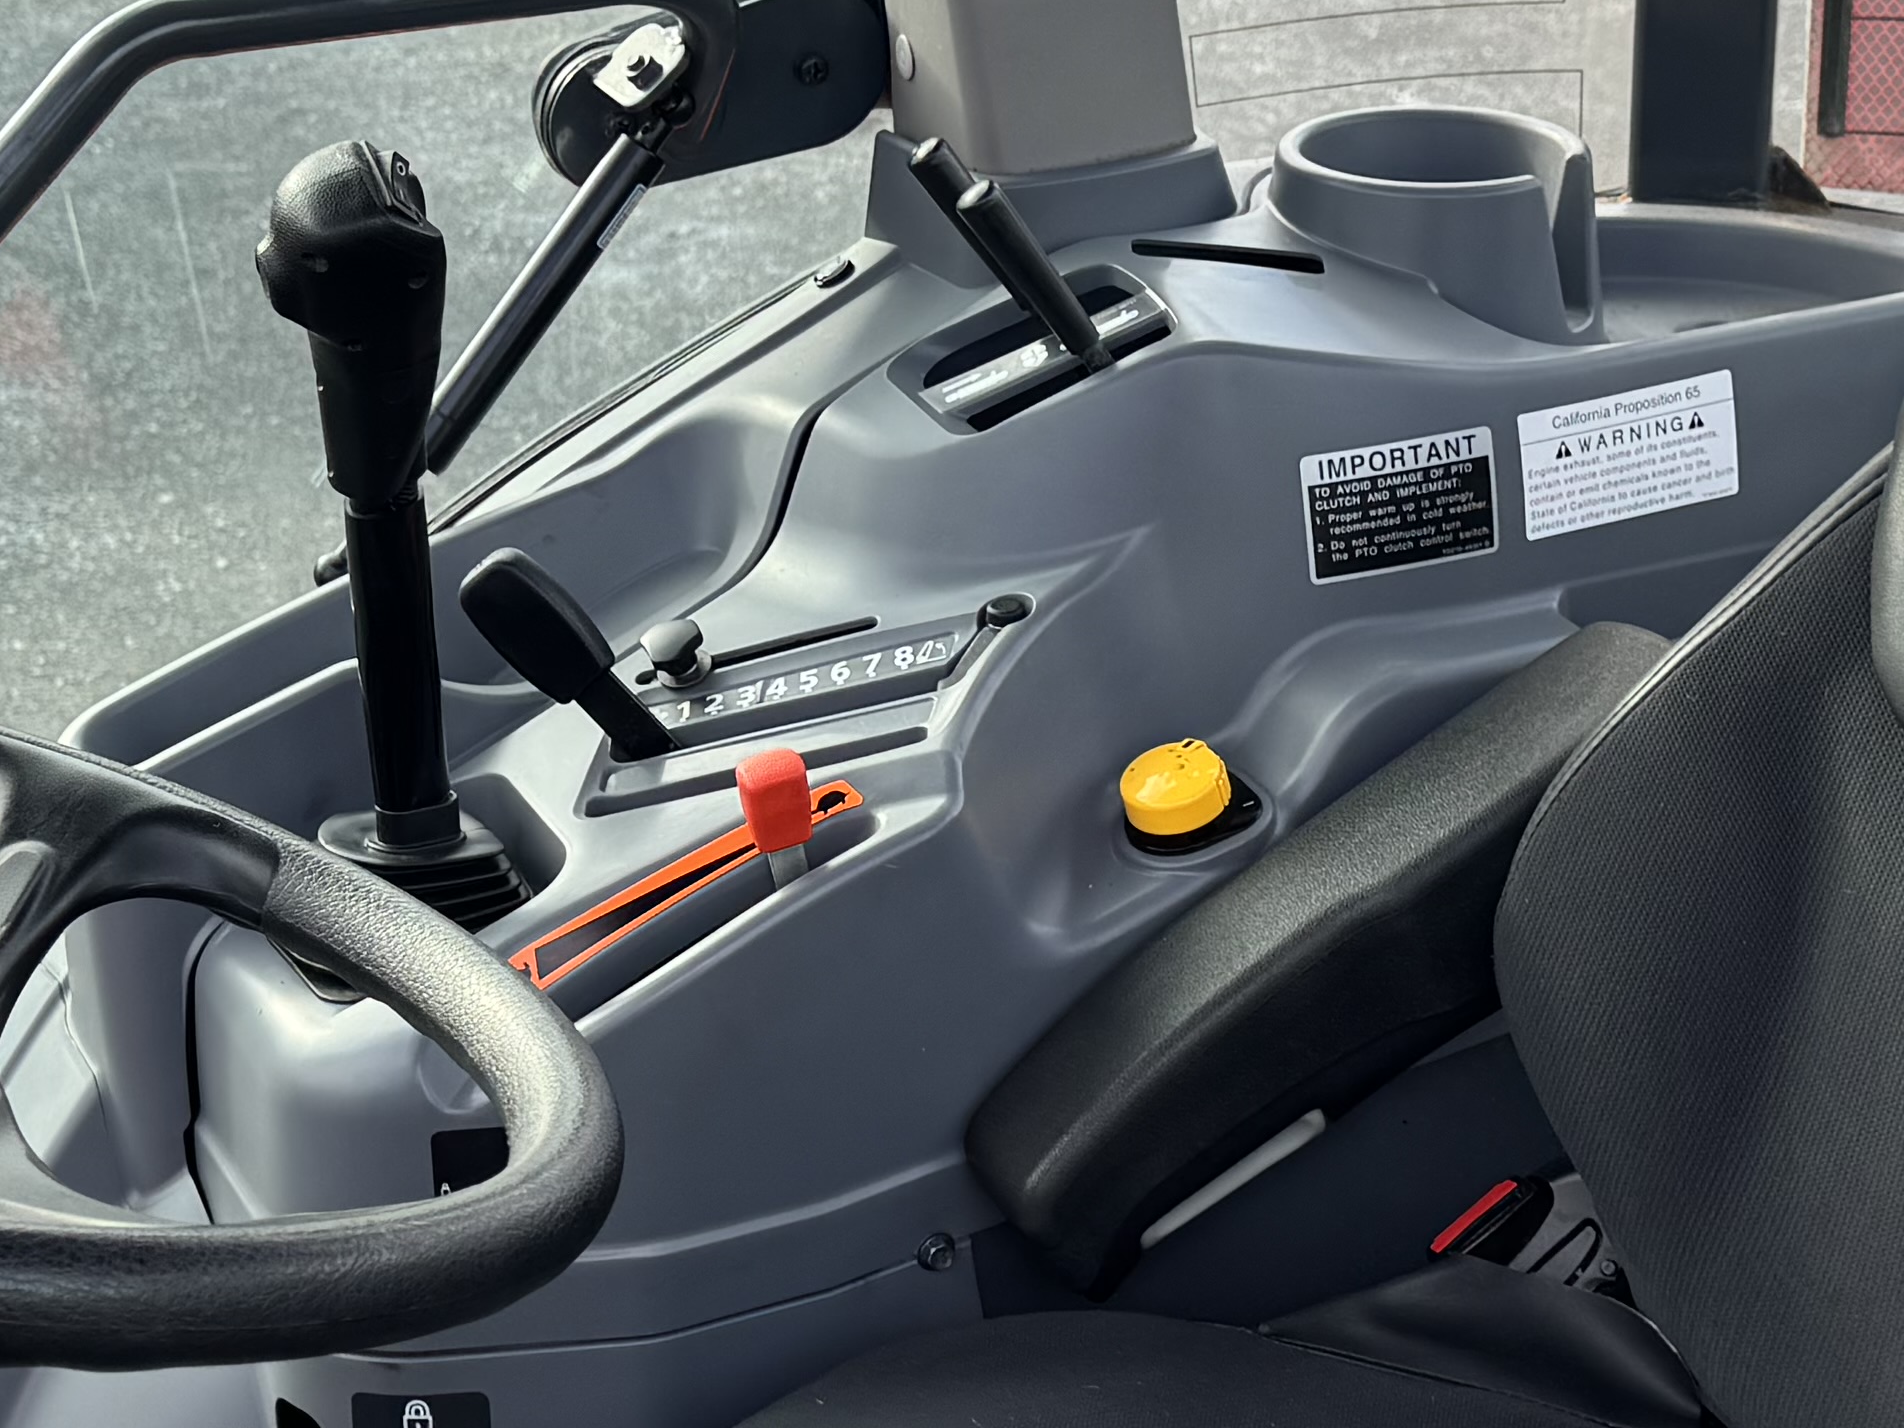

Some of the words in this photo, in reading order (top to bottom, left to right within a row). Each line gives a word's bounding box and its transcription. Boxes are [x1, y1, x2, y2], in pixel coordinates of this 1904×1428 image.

[1552, 407, 1611, 429] California
[1614, 390, 1682, 416] Proposition
[1685, 385, 1701, 400] 65
[1578, 416, 1684, 454] WARNING
[1318, 435, 1476, 481] IMPORTANT
[1527, 465, 1560, 480] Engine
[1563, 456, 1604, 471] exhaust,
[1606, 449, 1631, 462] some
[1634, 445, 1644, 456] of
[1528, 479, 1561, 493] certain
[1564, 471, 1597, 485] vehicle
[1600, 458, 1656, 479] components
[1660, 452, 1677, 464] and
[1315, 487, 1330, 498] TO
[1336, 480, 1372, 494] AVOID
[1377, 471, 1424, 489] DAMAGE
[1430, 467, 1445, 479] OF
[1451, 463, 1473, 475] PTO
[1315, 492, 1361, 511] CLUTCH
[1367, 490, 1390, 503] AND
[1396, 478, 1461, 498] IMPLEMENT:
[1529, 492, 1563, 508] contain
[1579, 483, 1600, 495] emit
[1602, 473, 1649, 491] chemicals
[1651, 466, 1682, 478] known
[1696, 459, 1711, 469] the
[1530, 508, 1555, 521] State
[1558, 503, 1567, 514] of
[1569, 494, 1615, 511] California
[1630, 485, 1658, 497] cause
[1661, 477, 1692, 491] cancer
[1695, 471, 1712, 483] and
[1328, 511, 1363, 524] Proper
[1368, 505, 1396, 517] warm
[1402, 503, 1415, 512] up
[1421, 499, 1430, 508] is
[1436, 490, 1474, 506] strongly
[1329, 515, 1401, 535] recommended
[1407, 514, 1416, 522] in
[1422, 508, 1443, 520] cold
[1531, 519, 1565, 534] defects
[1580, 510, 1606, 523] other
[1607, 496, 1666, 518] reproductive
[1330, 540, 1346, 551] Do
[1351, 537, 1368, 547] not
[1374, 524, 1436, 544] continuously
[1442, 521, 1461, 532] turn
[1332, 551, 1349, 562] the
[1355, 546, 1378, 558] PTO
[1384, 539, 1414, 554] clutch
[1420, 533, 1454, 547] control
[677, 701, 691, 721] 1
[704, 694, 723, 713] 2
[737, 686, 756, 704] 3
[766, 677, 788, 696] 4
[799, 670, 819, 689] 5
[830, 662, 850, 682] 6
[862, 654, 882, 673] 7
[894, 646, 914, 666] 8
